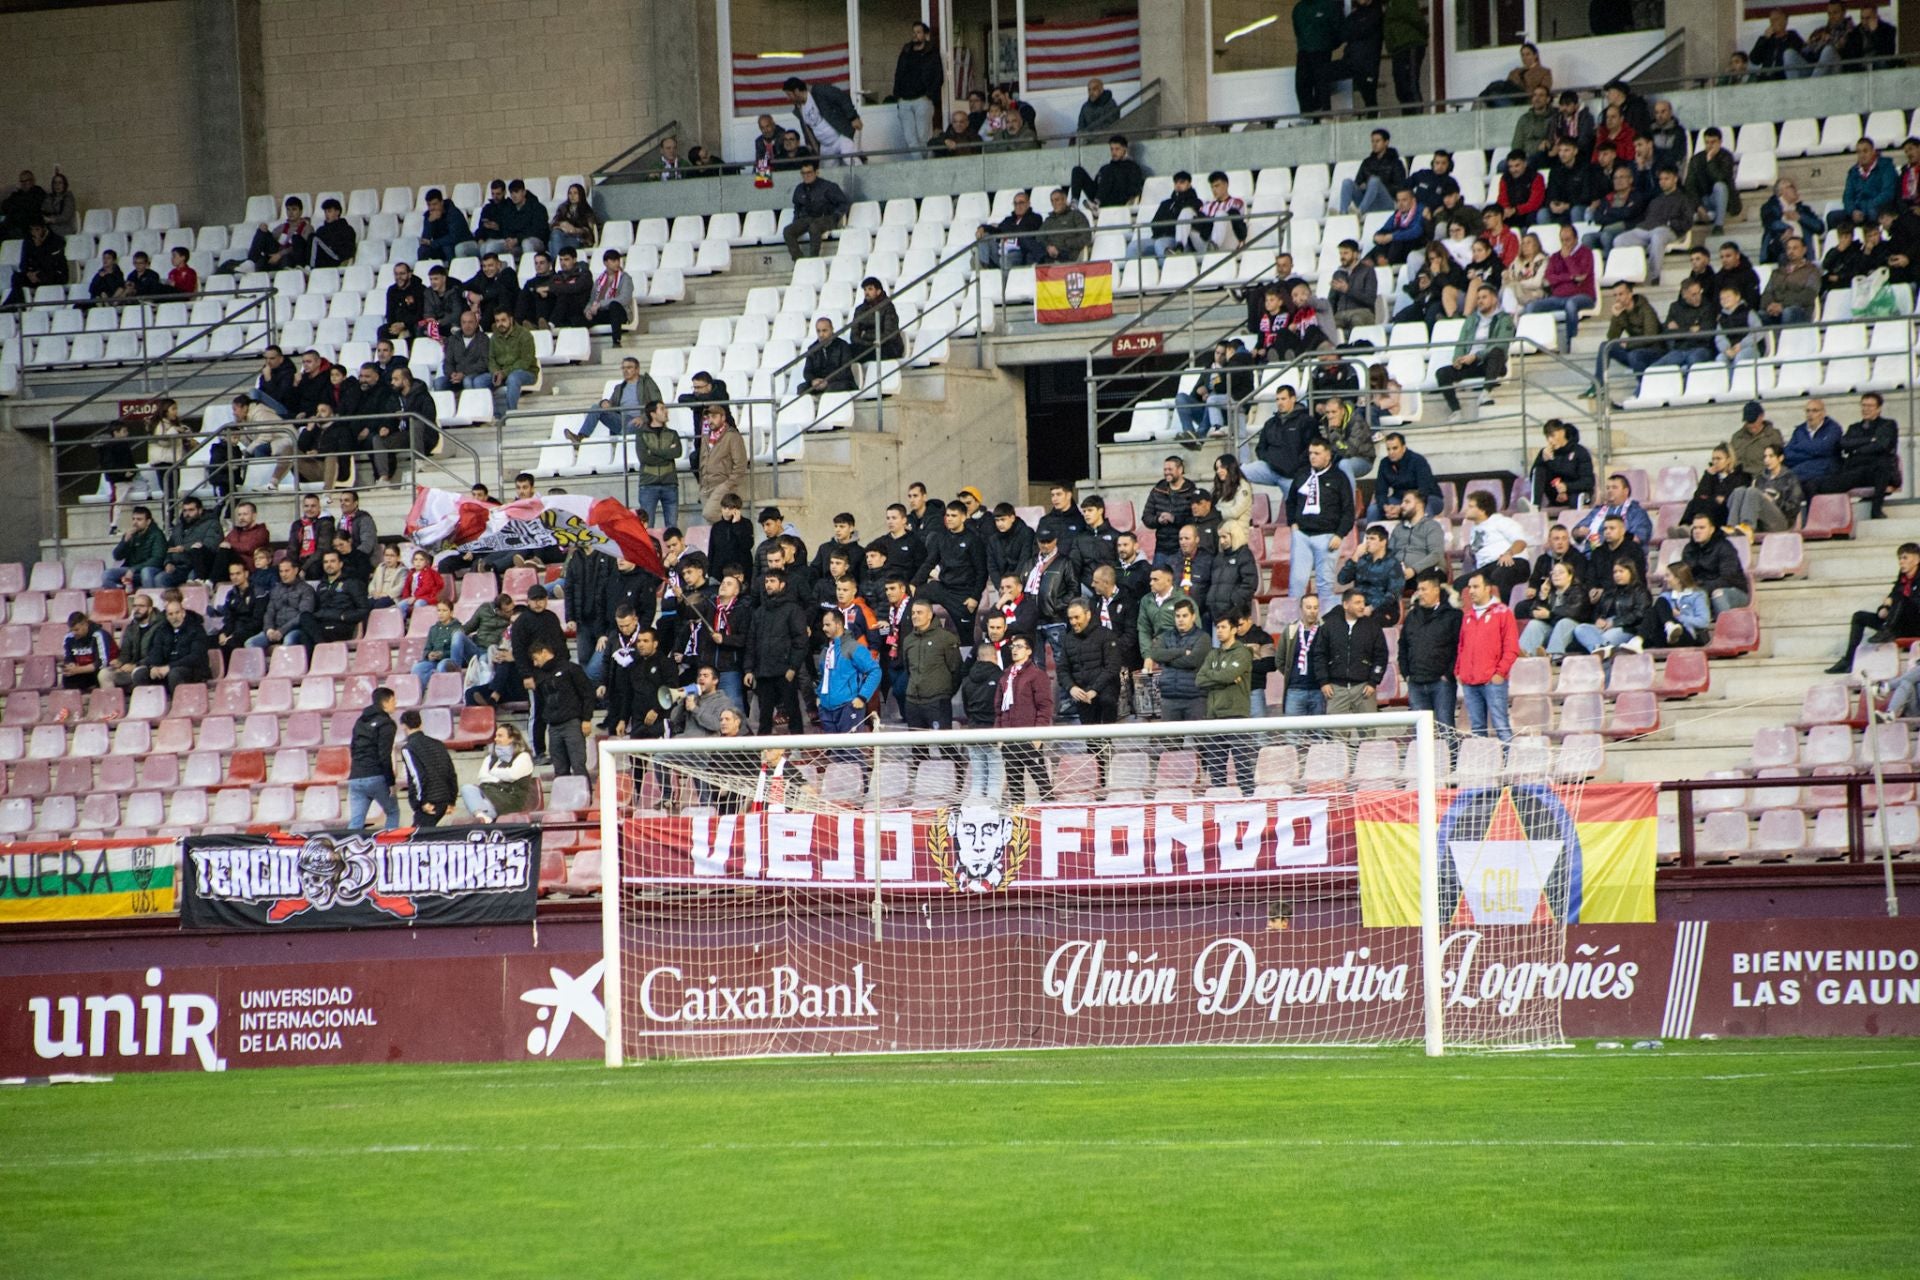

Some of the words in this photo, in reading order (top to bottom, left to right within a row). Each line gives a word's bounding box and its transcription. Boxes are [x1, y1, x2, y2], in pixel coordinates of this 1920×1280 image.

[1040, 799, 1329, 878] FONDO
[190, 848, 301, 899] TERCIO
[375, 832, 528, 894] LOGROÑÉS
[1043, 939, 1177, 1016] Unión
[1193, 937, 1409, 1021] Deportiva
[1439, 930, 1640, 1017] Logroñés
[1732, 949, 1919, 975] BIENVENIDO
[240, 987, 353, 1009] UNIVERSIDAD
[639, 962, 880, 1022] CaixaBank
[1733, 980, 1801, 1007] LAS
[240, 1008, 377, 1030] INTERNACIONAL
[239, 1034, 262, 1053] DE
[266, 1033, 287, 1052] LA
[290, 1031, 342, 1051] RIOJA
